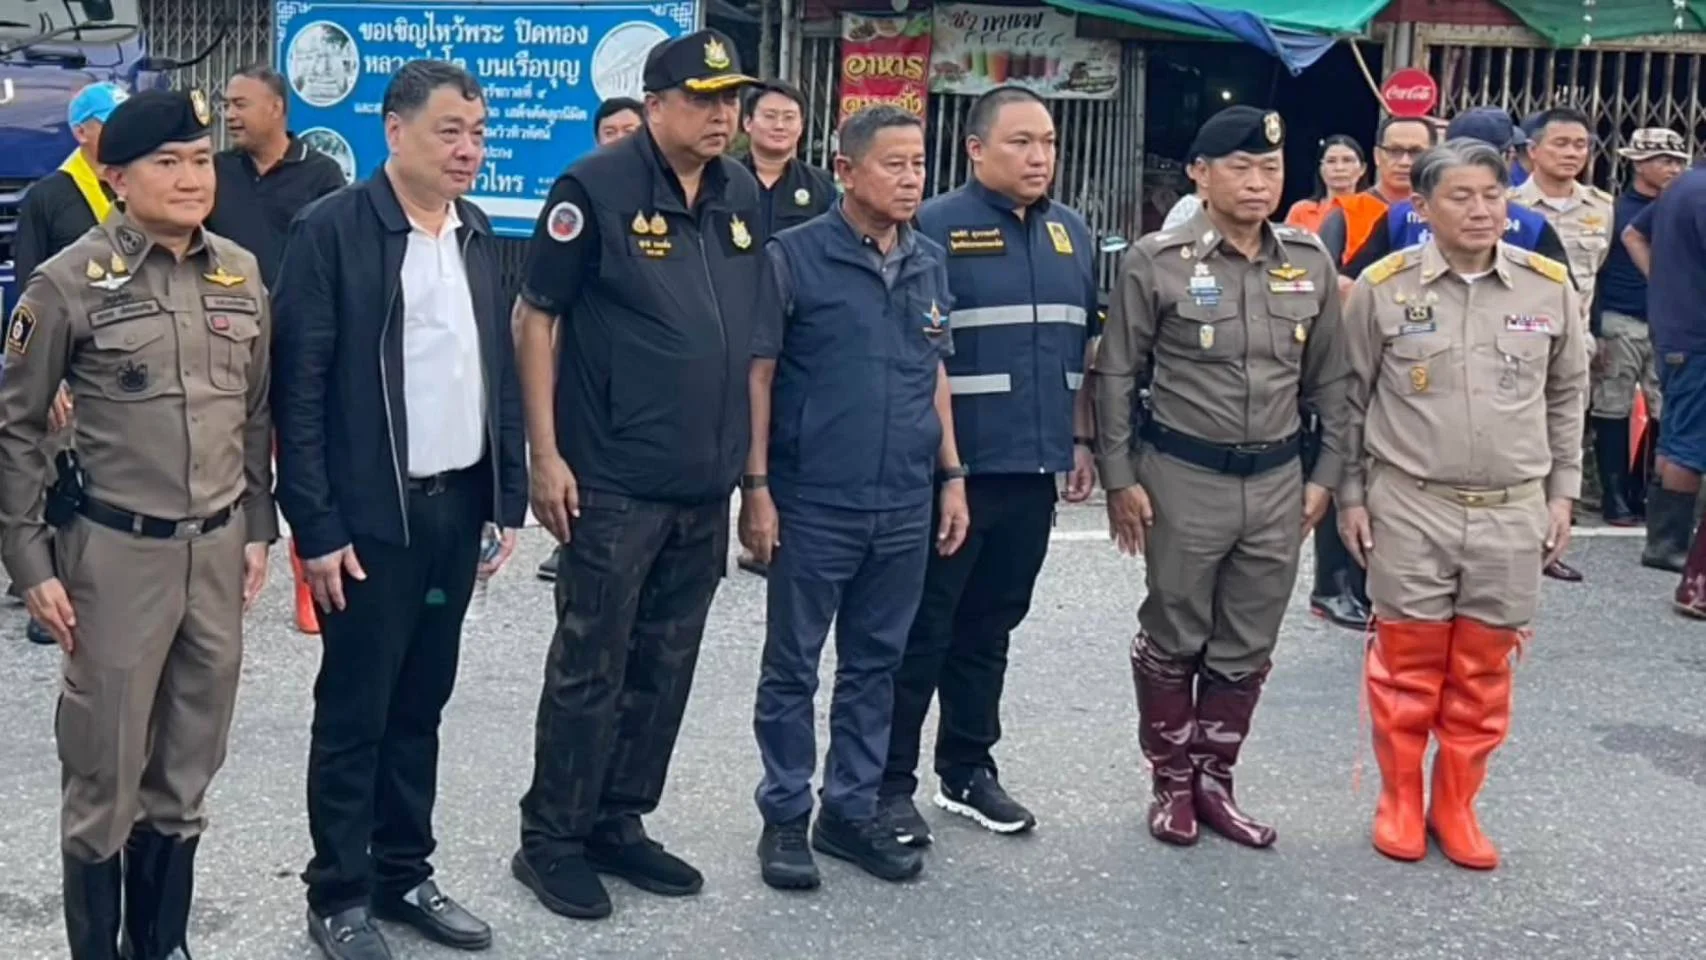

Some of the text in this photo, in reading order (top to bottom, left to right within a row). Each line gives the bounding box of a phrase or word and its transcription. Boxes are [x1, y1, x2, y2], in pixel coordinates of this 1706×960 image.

[358, 11, 589, 48] ขอเชิญไหว้พระ ปิดทอง
[477, 51, 581, 88] บนเรือบุญ
[845, 54, 925, 84] อาหาร
